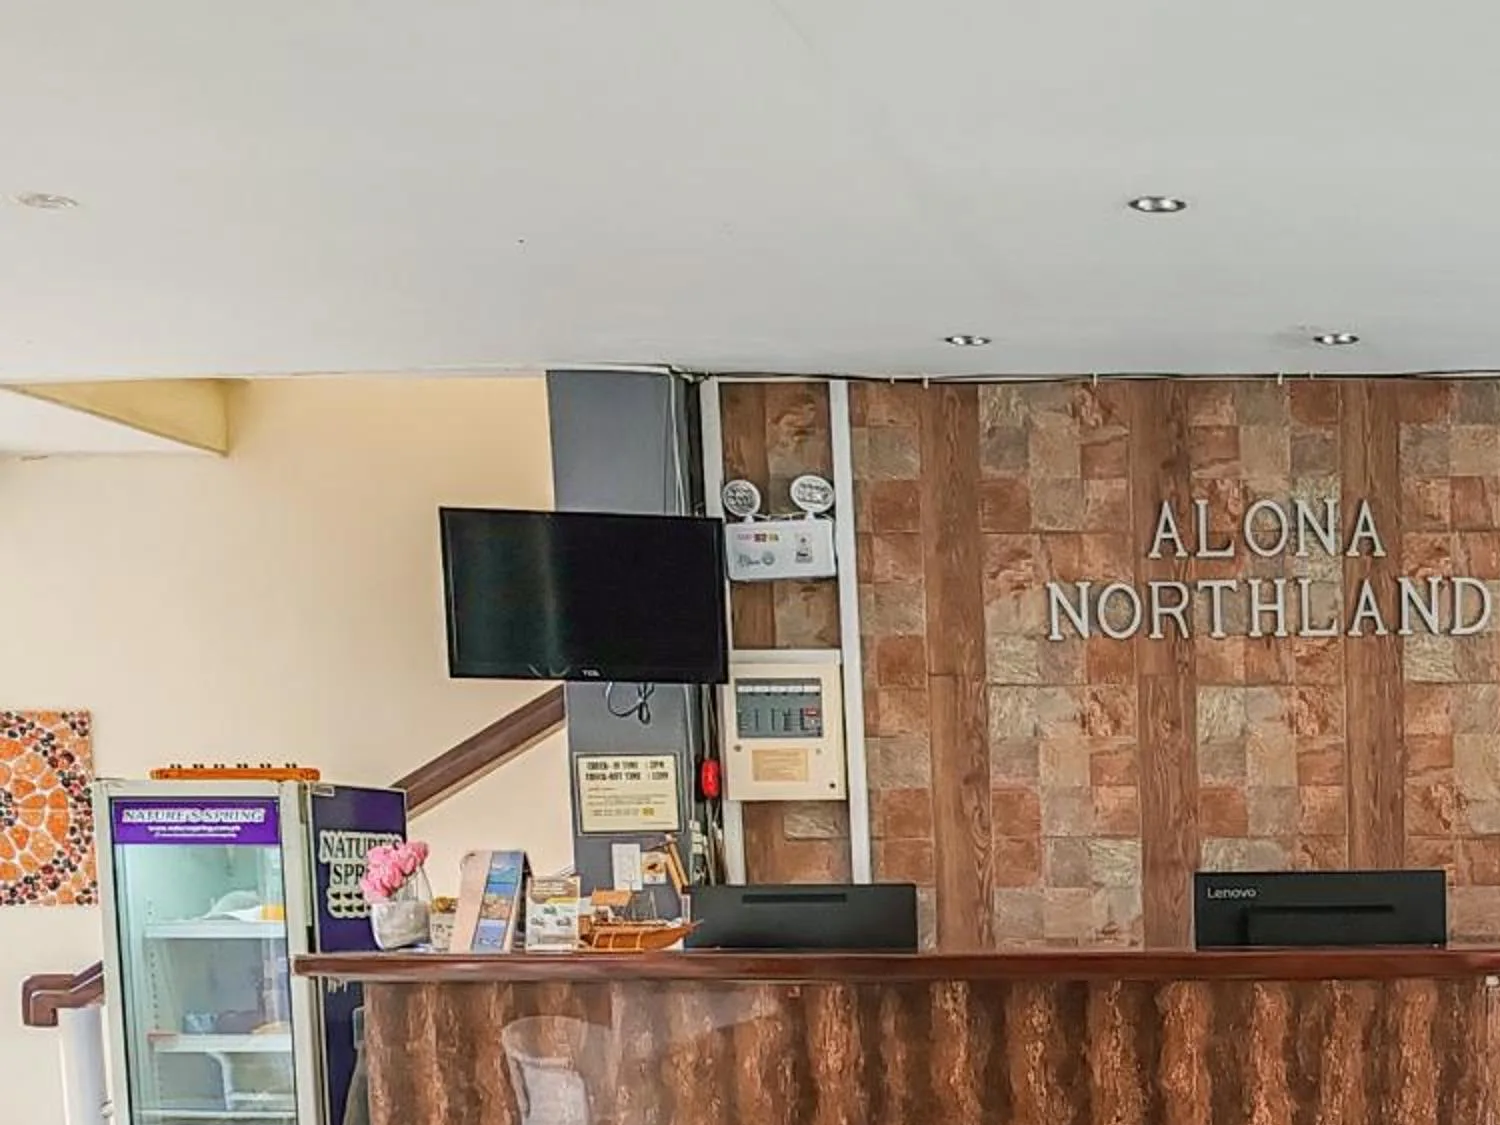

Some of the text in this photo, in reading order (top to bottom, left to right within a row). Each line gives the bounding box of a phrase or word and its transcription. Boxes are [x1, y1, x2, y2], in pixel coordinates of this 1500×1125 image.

[1147, 498, 1387, 559] ALONA
[1045, 576, 1493, 641] NORTHLAND
[123, 808, 265, 823] NATURE'S SPRING
[1207, 886, 1257, 899] Lenovo
